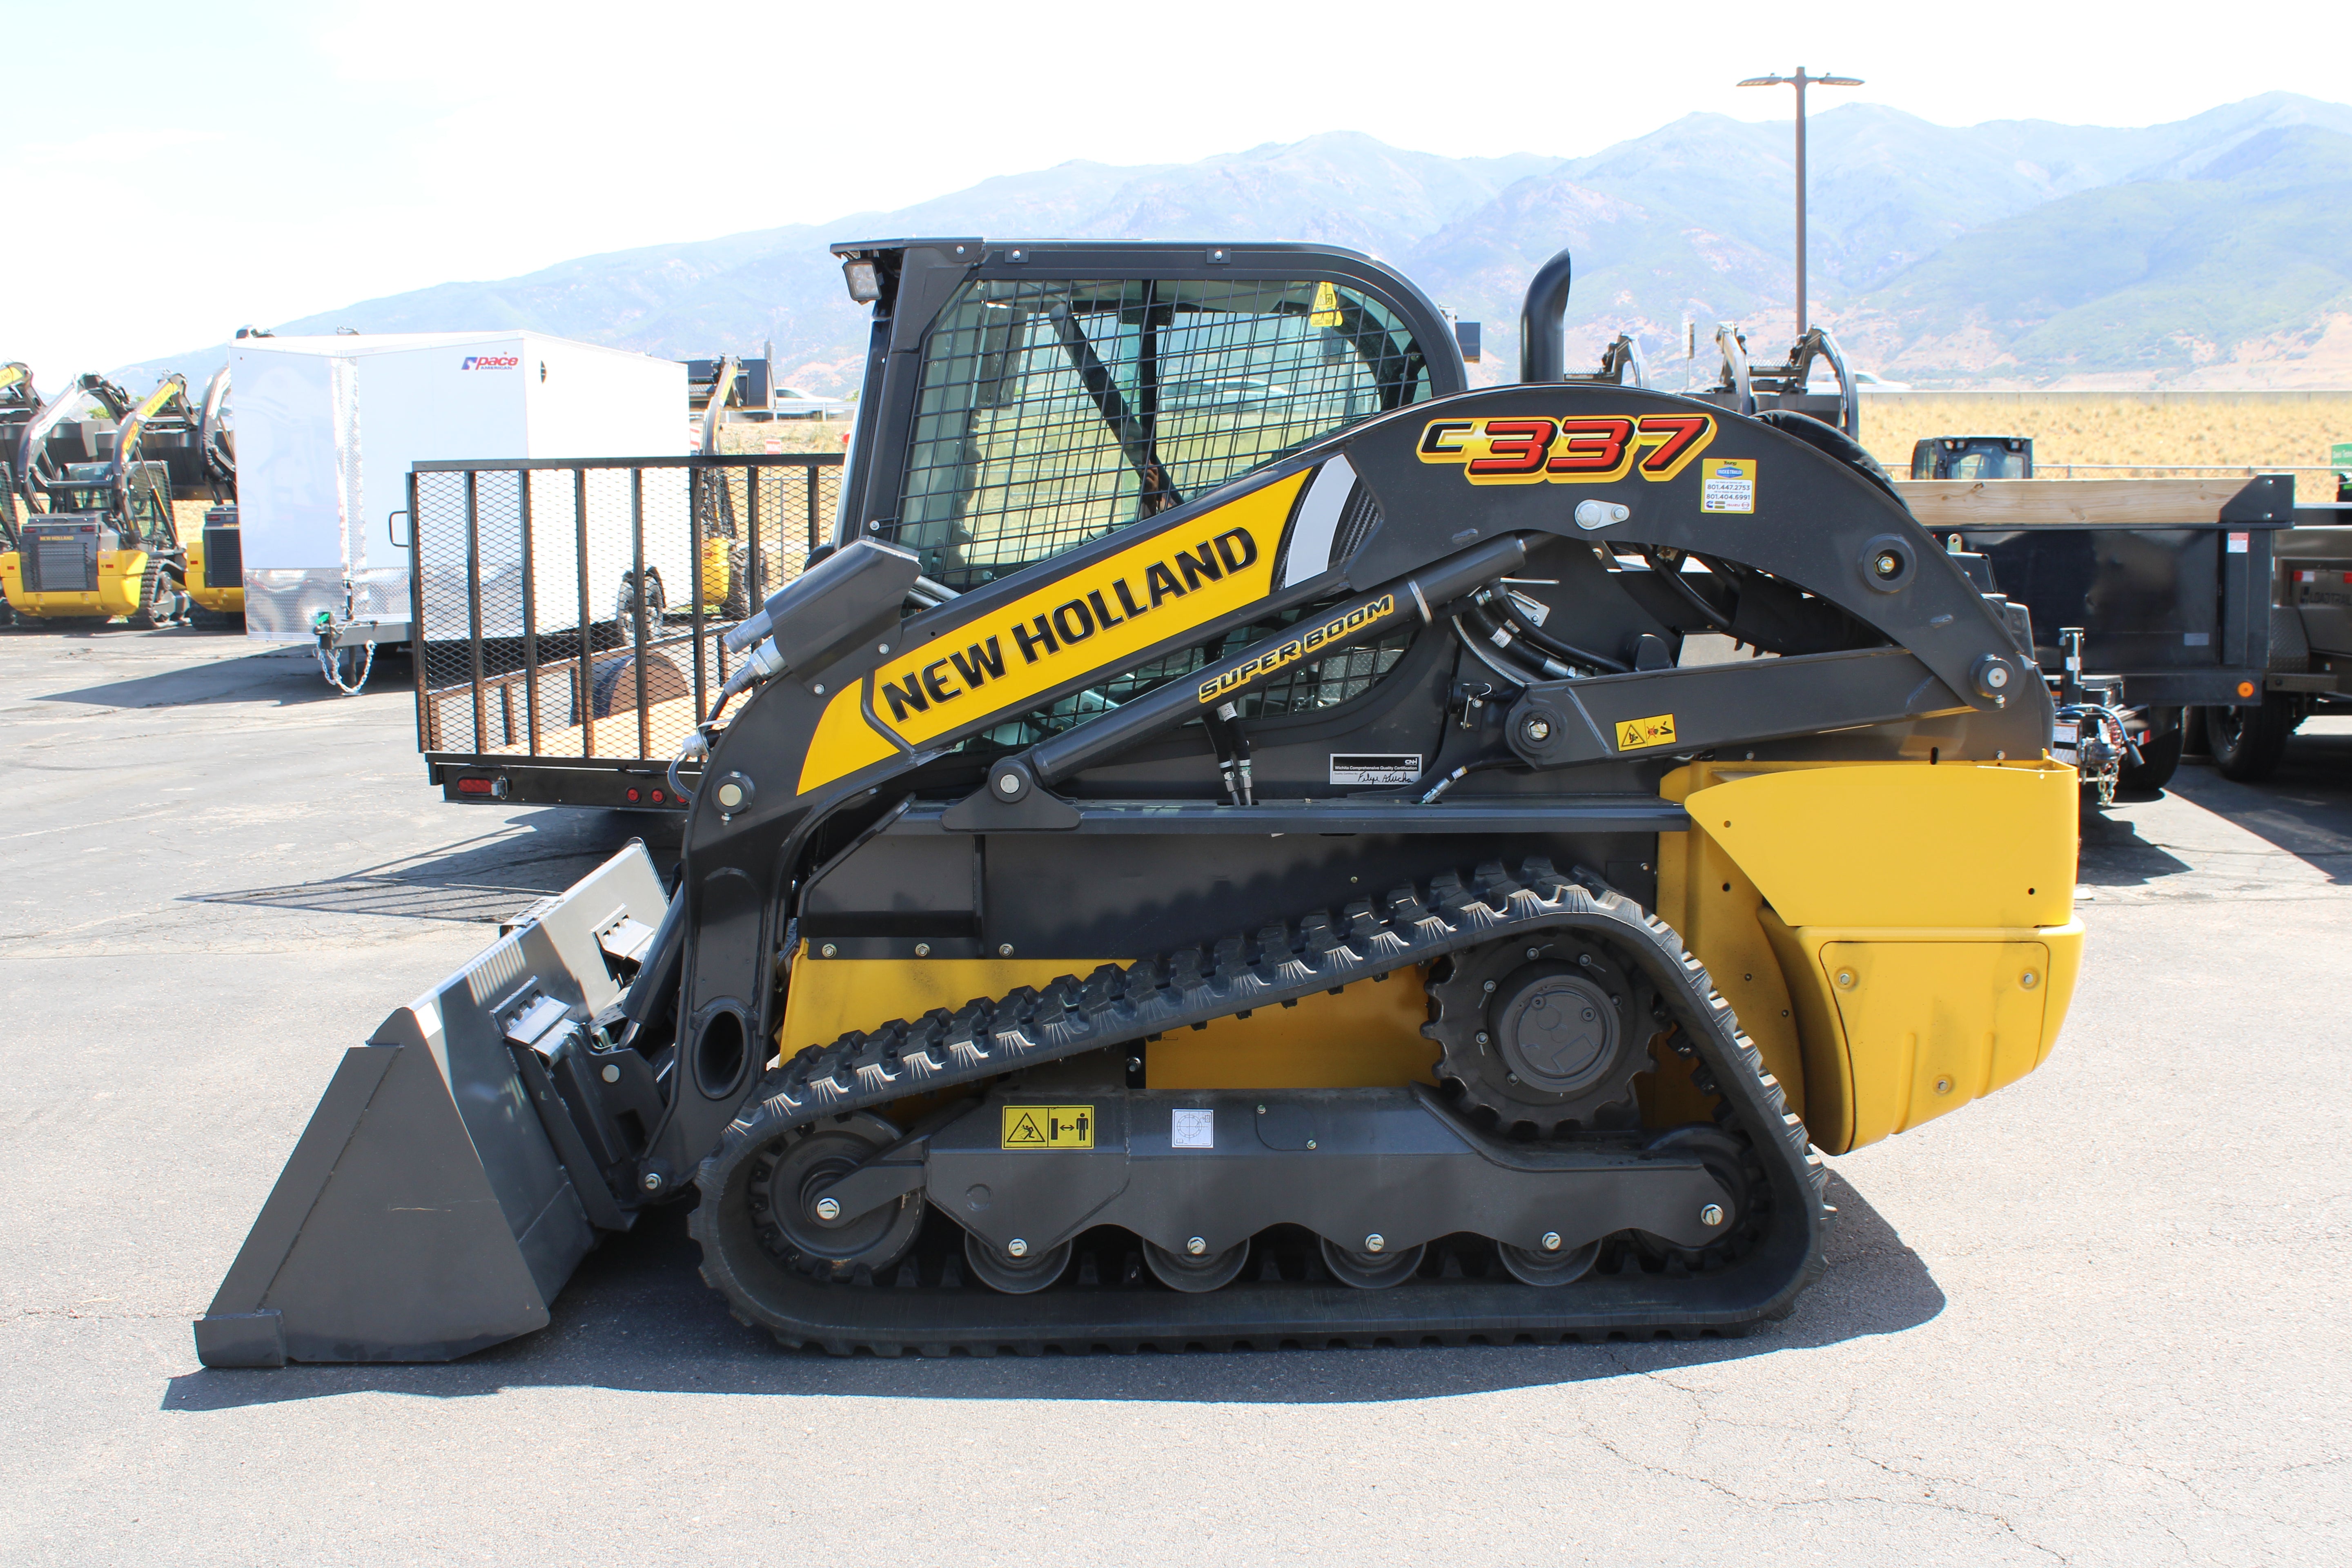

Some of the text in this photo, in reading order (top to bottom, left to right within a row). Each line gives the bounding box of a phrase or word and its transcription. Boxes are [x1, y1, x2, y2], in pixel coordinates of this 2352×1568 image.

[475, 357, 518, 370] pace
[1420, 416, 1711, 475] C337
[880, 527, 1259, 724] NEW HOLLAND
[1198, 595, 1394, 703] SUPER BOOM
